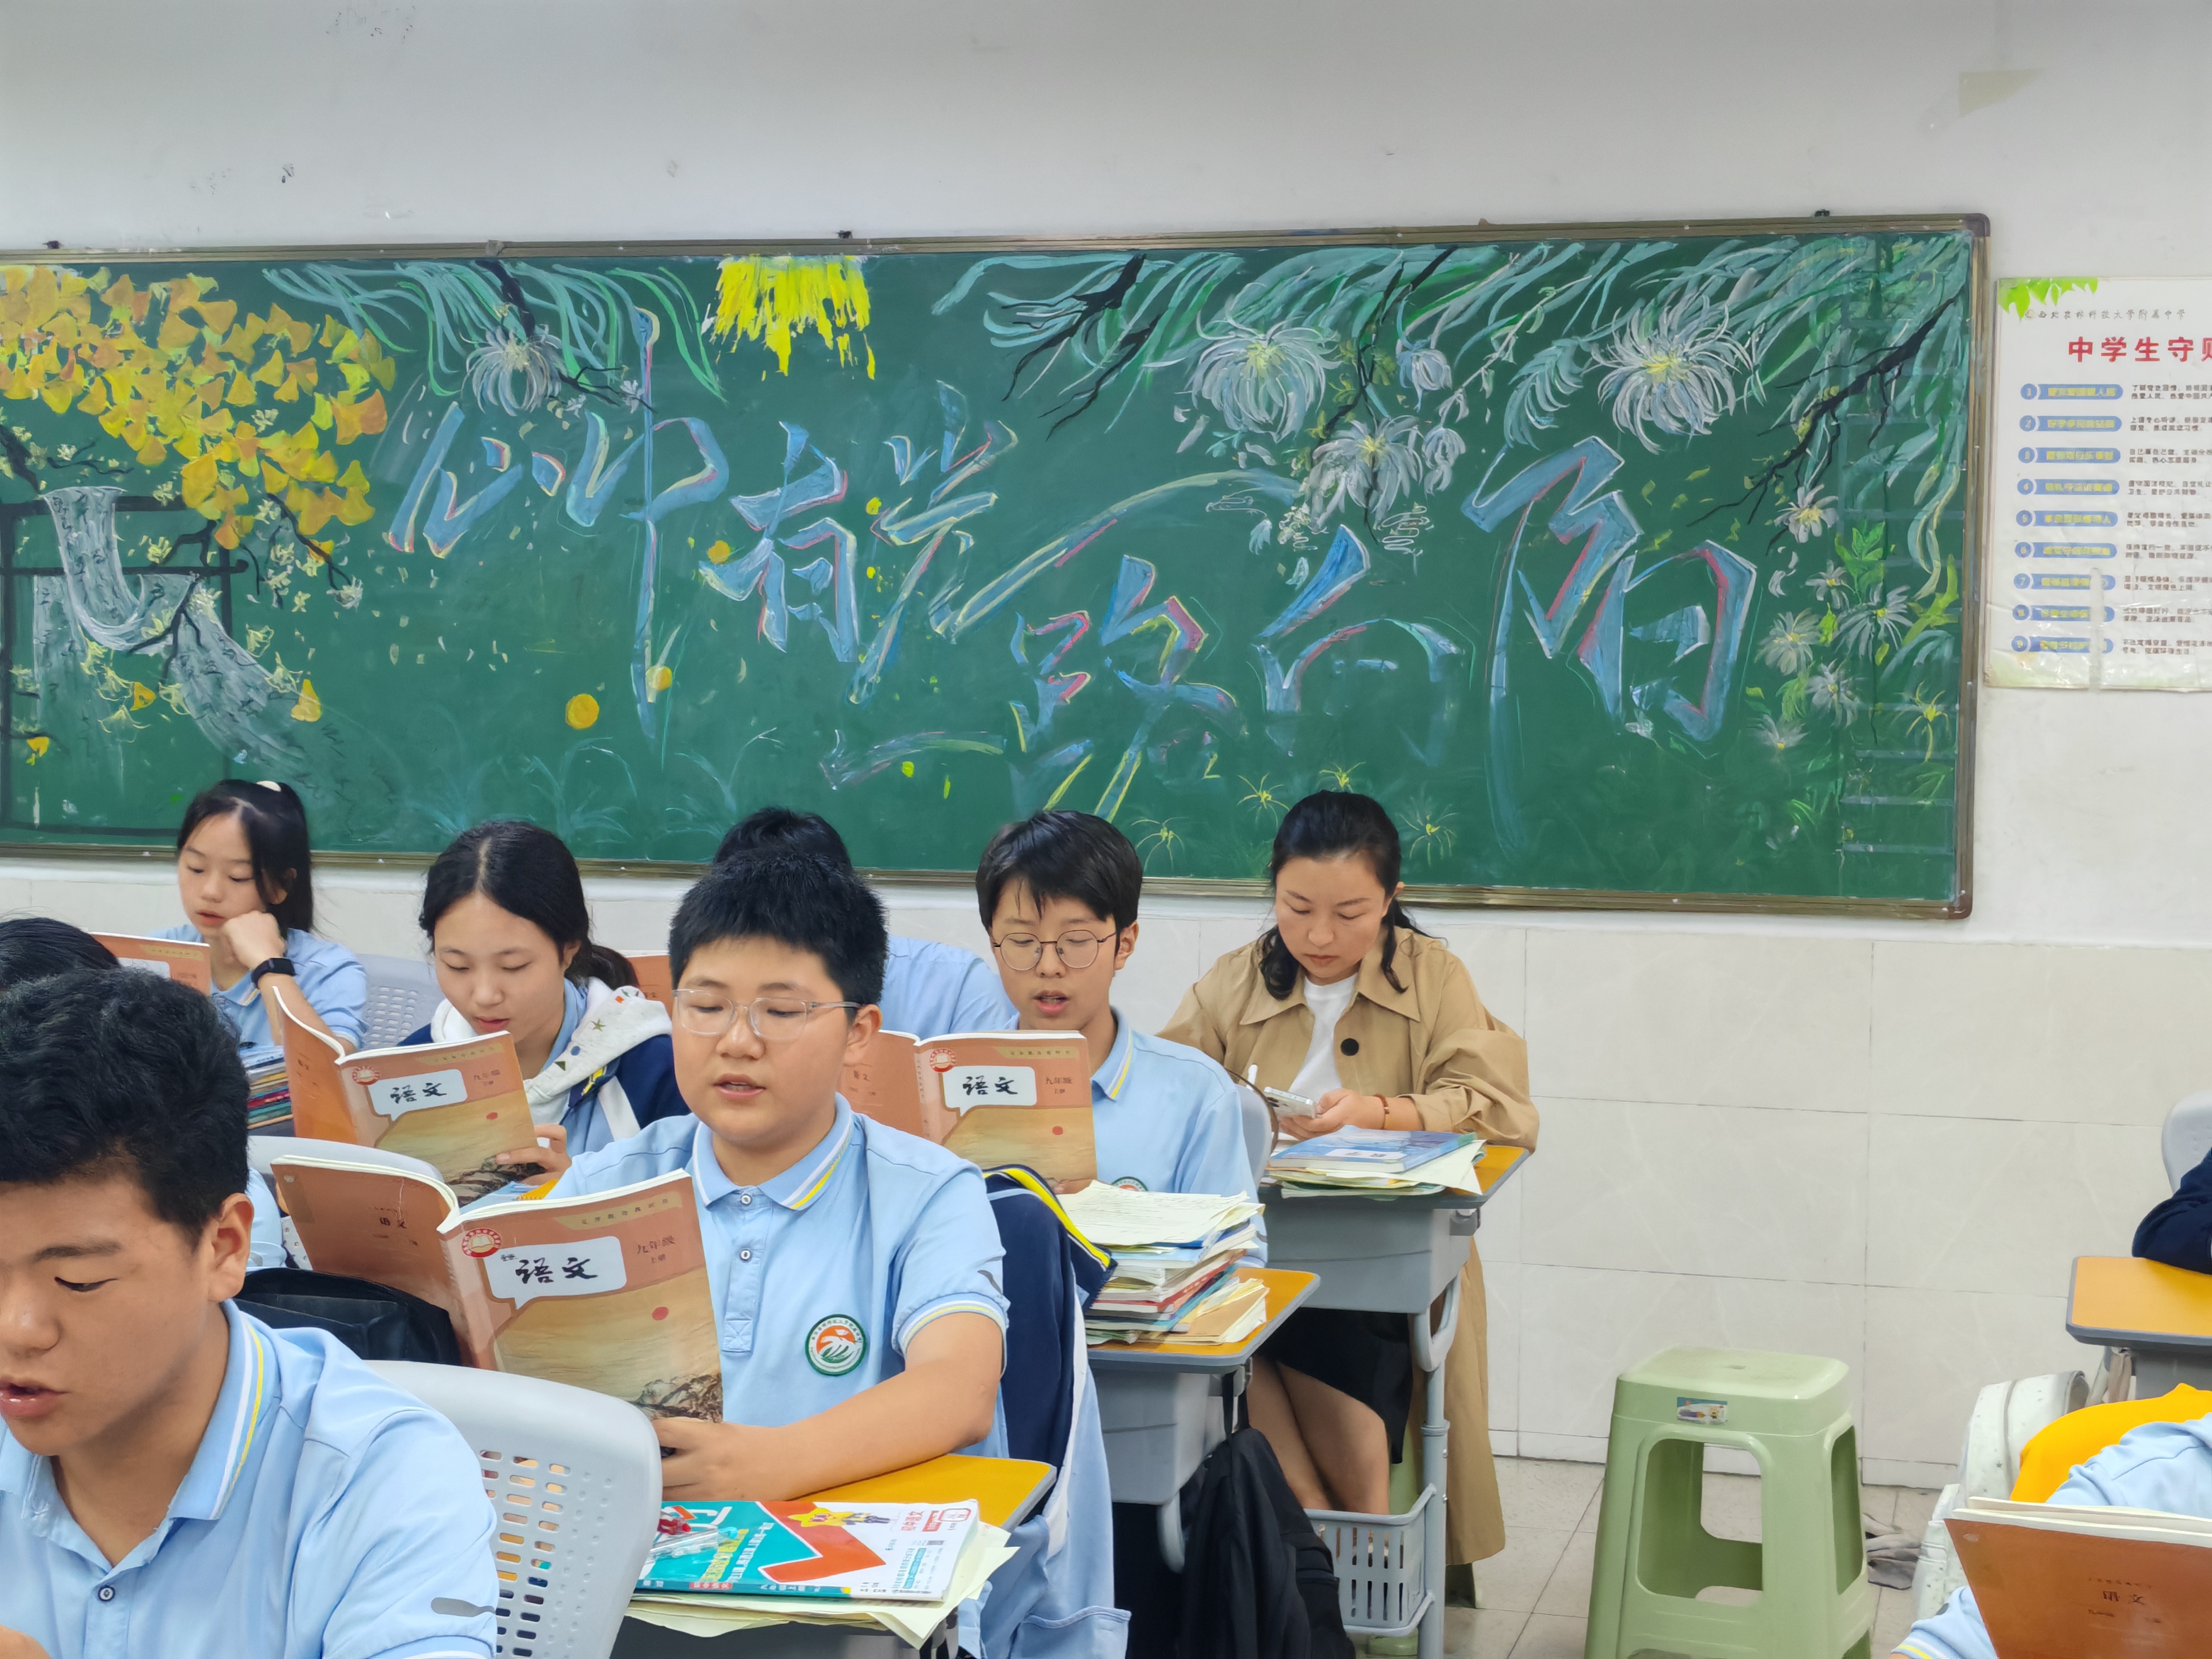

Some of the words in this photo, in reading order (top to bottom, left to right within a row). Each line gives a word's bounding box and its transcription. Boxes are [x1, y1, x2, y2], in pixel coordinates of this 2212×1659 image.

[390, 1082, 447, 1104] 语文
[962, 1075, 1019, 1096] 语文
[515, 1257, 598, 1284] 语文
